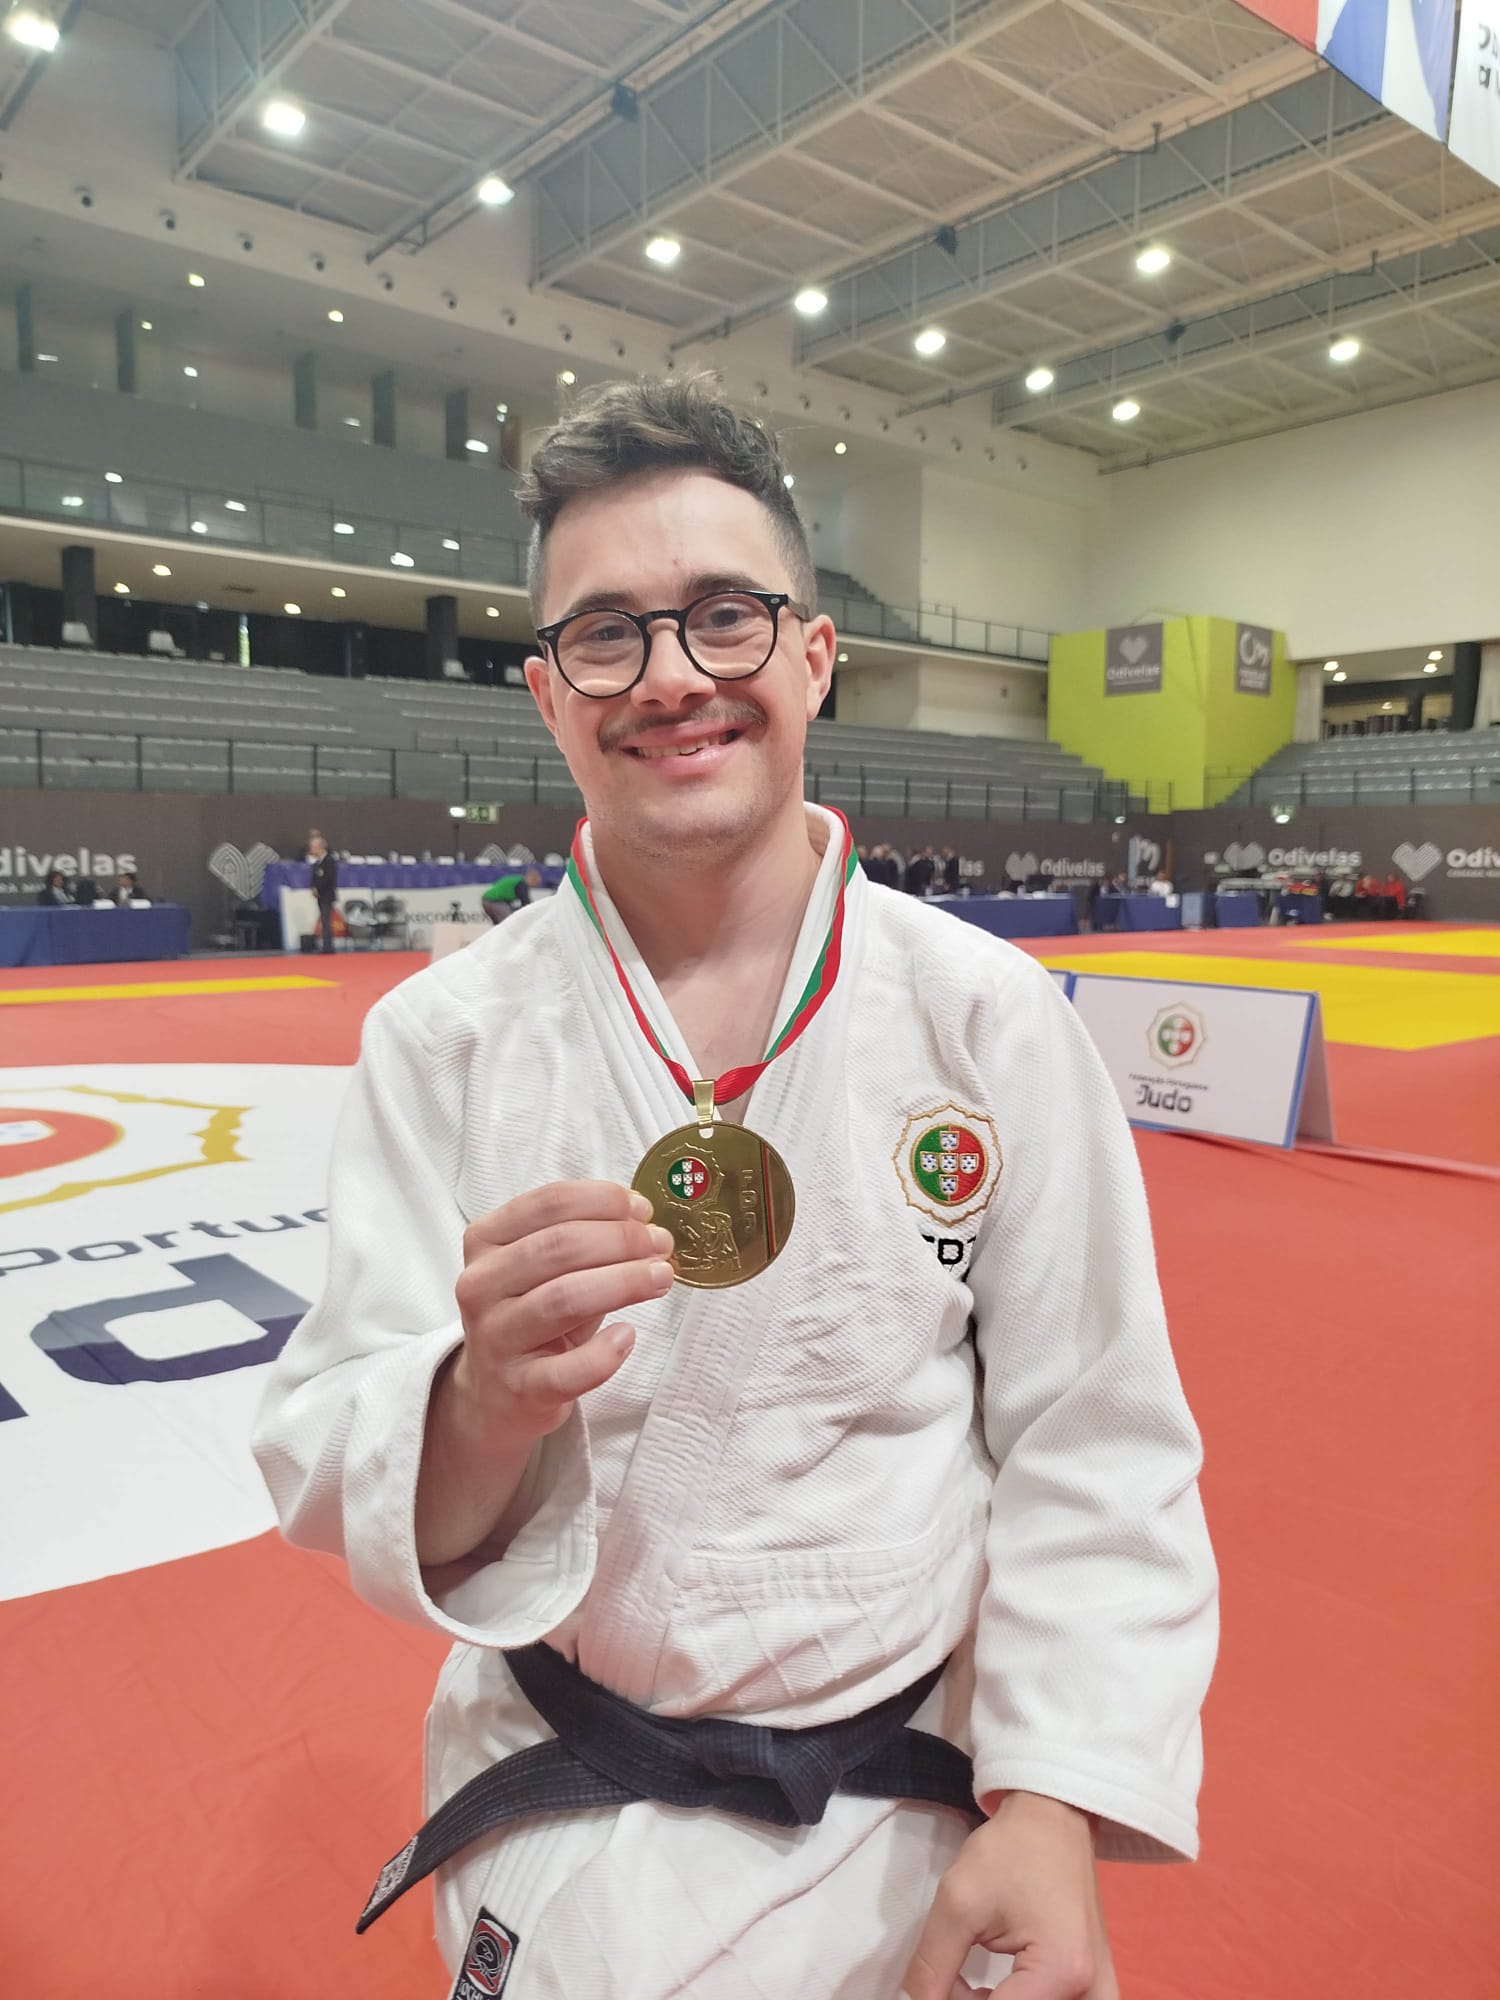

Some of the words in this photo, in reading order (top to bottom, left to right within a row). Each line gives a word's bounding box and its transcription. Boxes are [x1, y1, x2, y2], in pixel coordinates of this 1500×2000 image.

[1040, 857, 1105, 877] Odivelas
[1268, 846, 1362, 867] Odivelas
[1136, 1084, 1193, 1114] Judo
